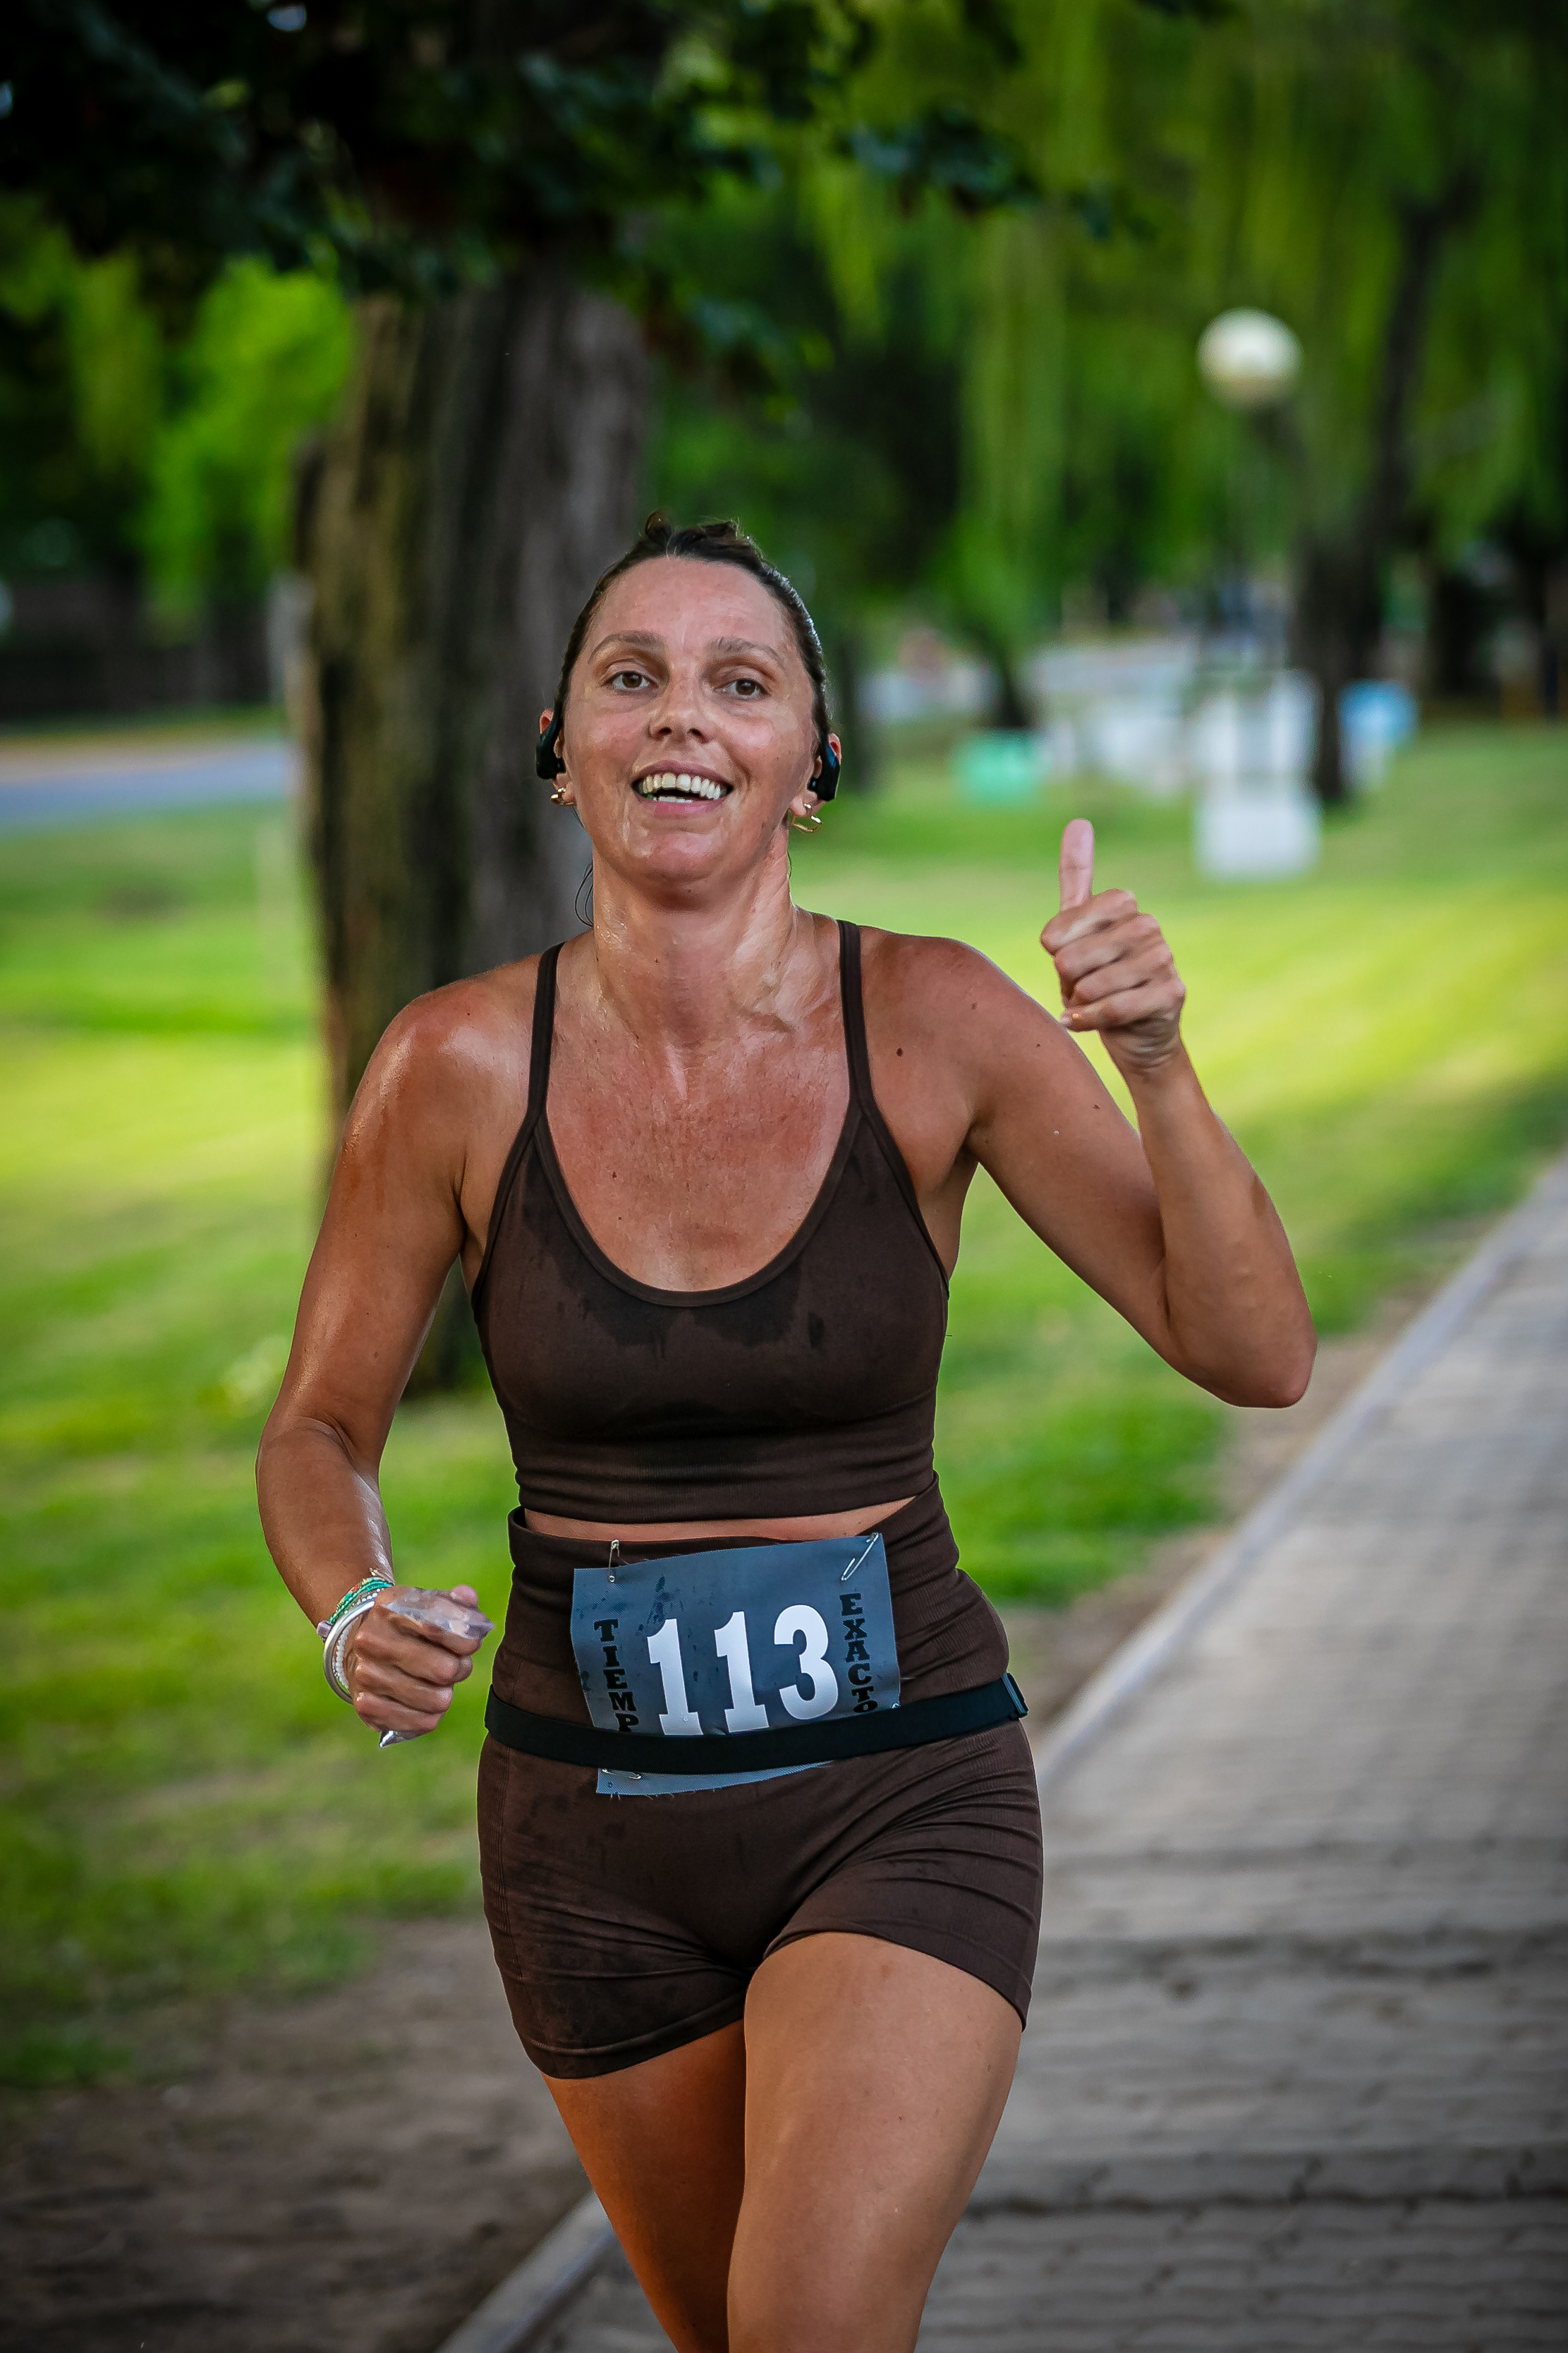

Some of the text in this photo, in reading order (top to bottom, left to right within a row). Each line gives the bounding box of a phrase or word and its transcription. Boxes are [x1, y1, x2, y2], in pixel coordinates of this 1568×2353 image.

[593, 1619, 640, 1733] TIEMP
[647, 1604, 839, 1736] 113
[839, 1592, 879, 1714] EXACTO
